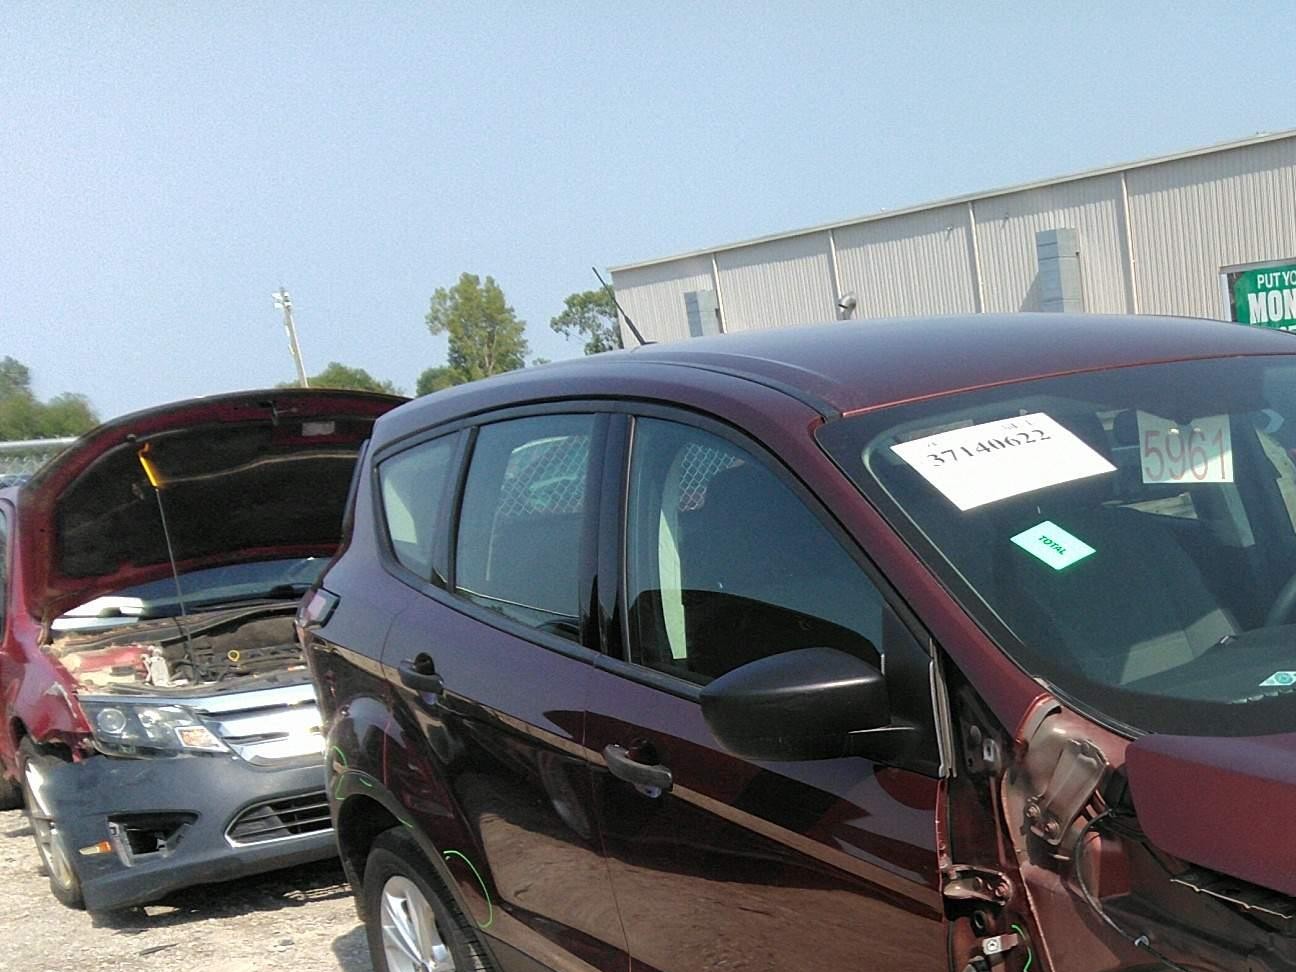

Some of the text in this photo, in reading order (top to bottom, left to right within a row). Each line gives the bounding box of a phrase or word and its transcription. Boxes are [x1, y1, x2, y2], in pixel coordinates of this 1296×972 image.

[1257, 272, 1280, 289] PUT
[926, 429, 1052, 467] 37140622
[1144, 427, 1226, 481] 5961
[1038, 535, 1067, 556] TOTAL
